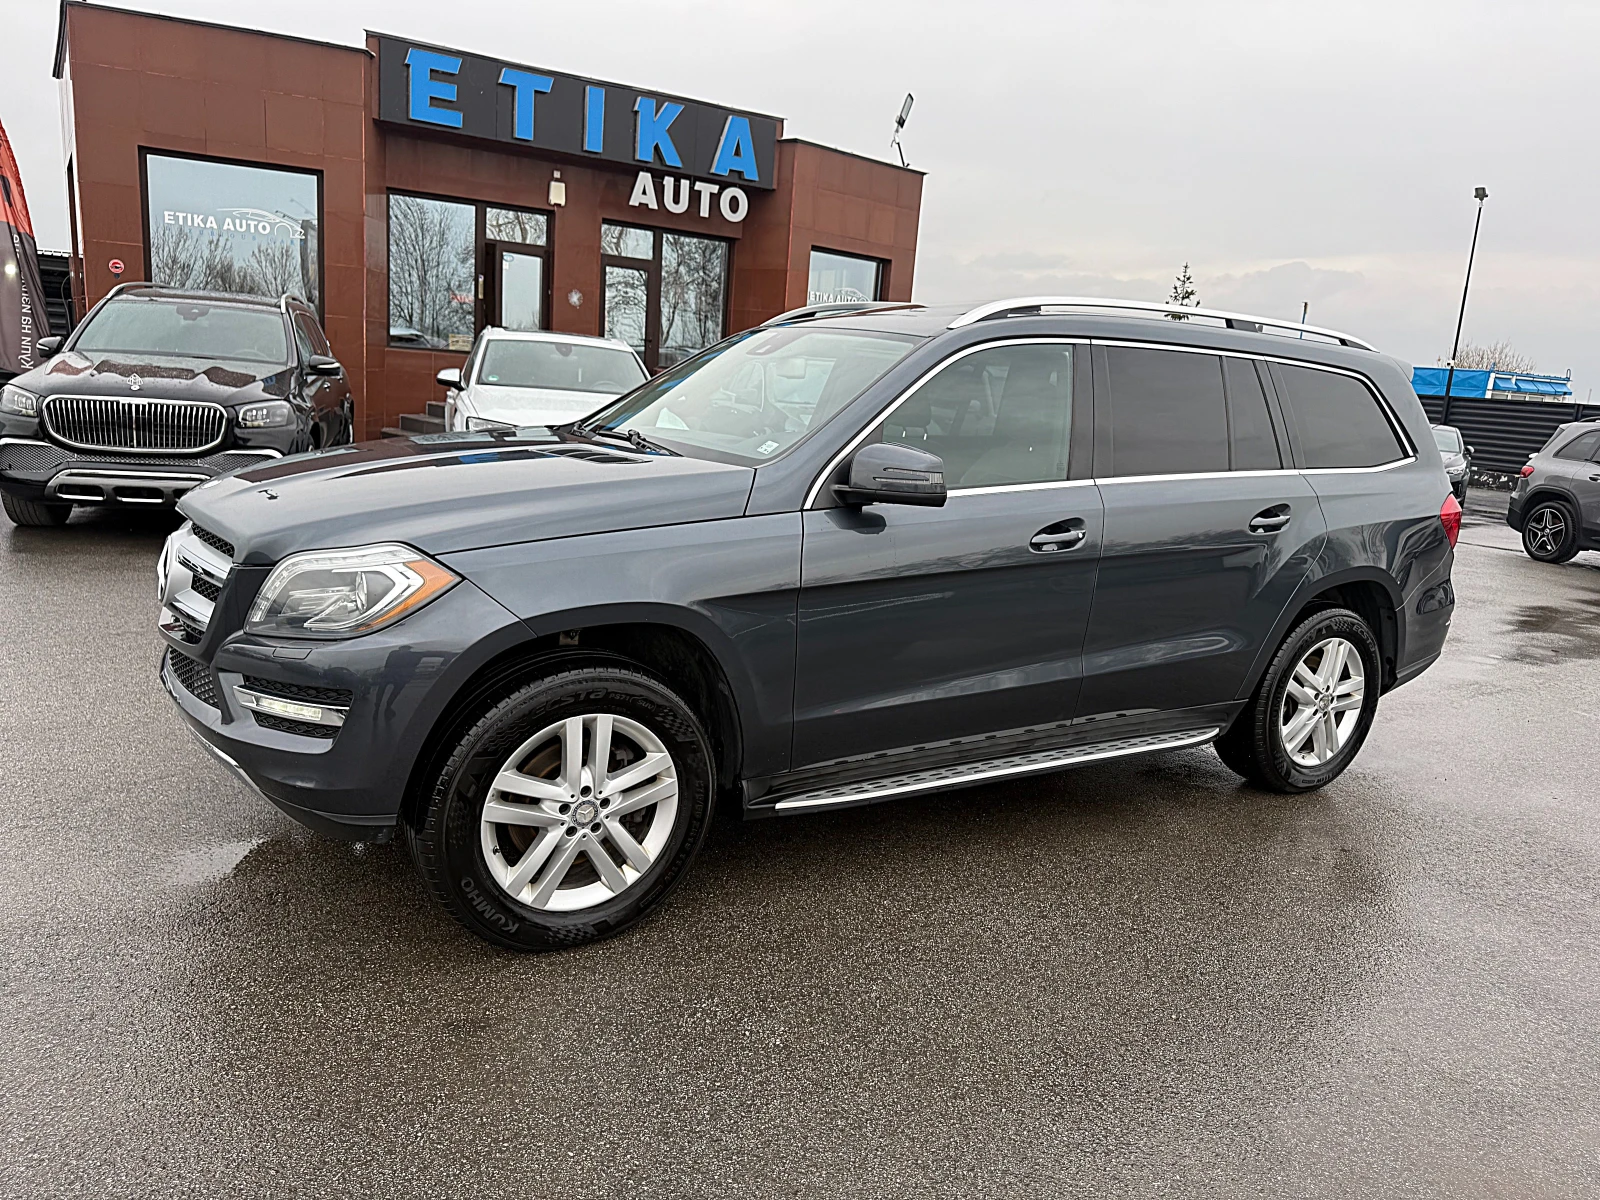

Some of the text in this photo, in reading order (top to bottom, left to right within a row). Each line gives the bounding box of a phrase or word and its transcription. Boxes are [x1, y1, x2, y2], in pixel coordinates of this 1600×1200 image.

[405, 47, 759, 181] ETIKA
[164, 210, 271, 235] ETIKA AUTO
[629, 171, 749, 222] AUTO
[460, 876, 520, 934] KUMHO
